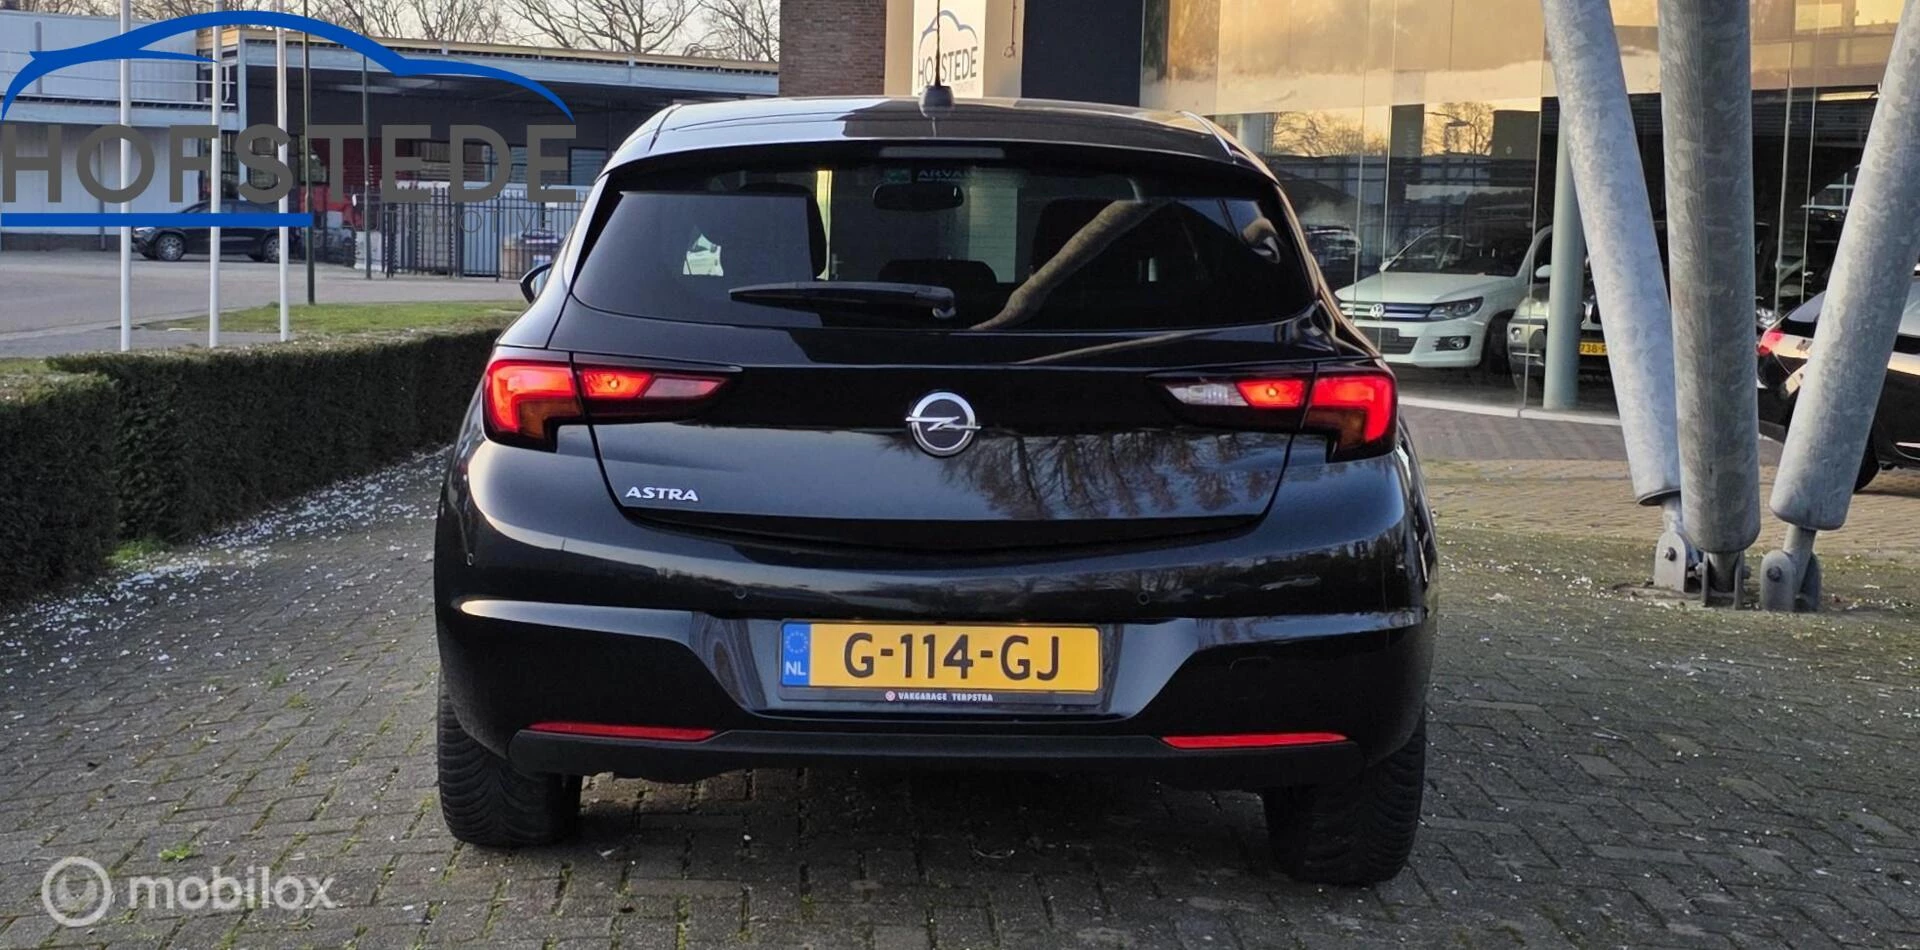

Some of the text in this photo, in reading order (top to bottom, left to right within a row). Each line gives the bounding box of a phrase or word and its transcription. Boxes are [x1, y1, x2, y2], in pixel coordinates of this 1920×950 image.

[918, 46, 978, 88] HOSTEDE
[625, 486, 699, 502] ASTRA
[843, 632, 1060, 681] G-114-GJ
[785, 661, 806, 676] NL
[898, 692, 994, 702] VAKGARAGE TERPSTRA
